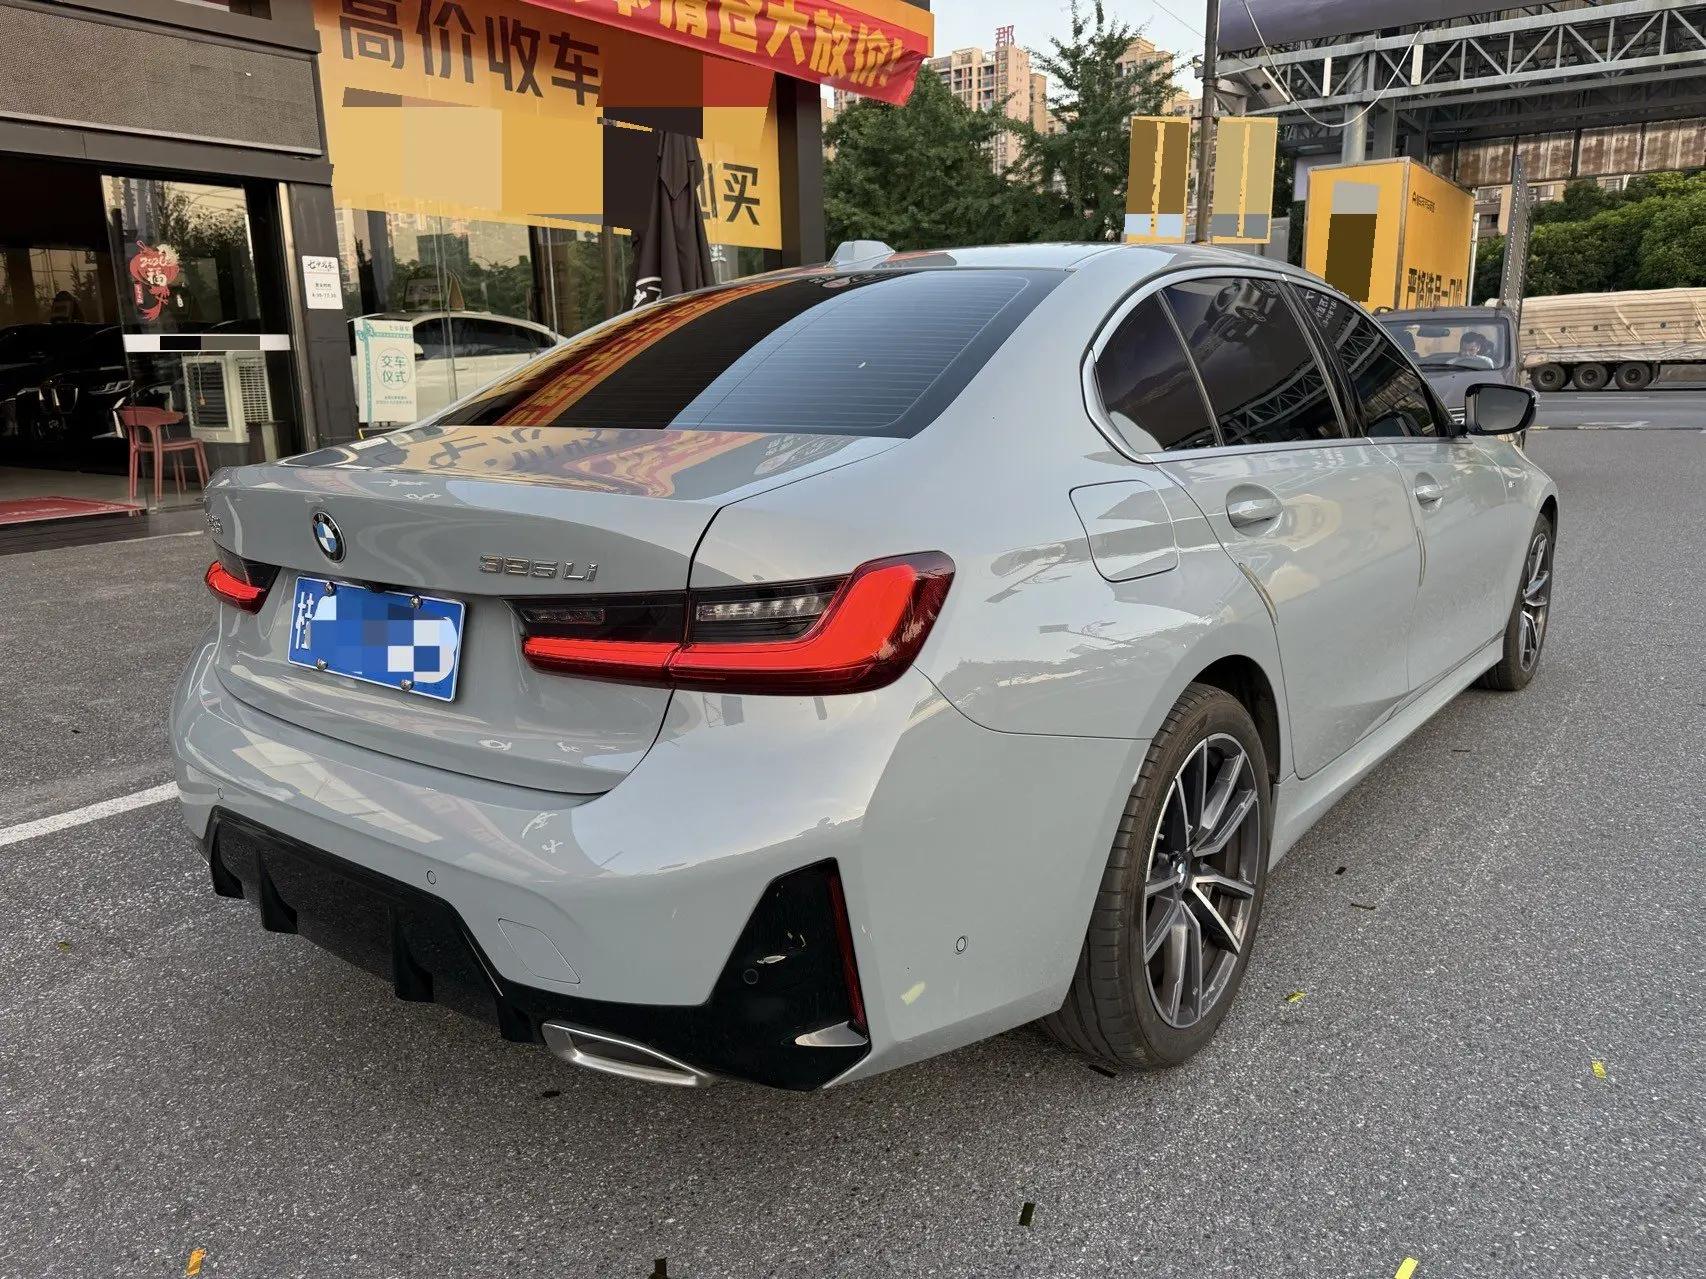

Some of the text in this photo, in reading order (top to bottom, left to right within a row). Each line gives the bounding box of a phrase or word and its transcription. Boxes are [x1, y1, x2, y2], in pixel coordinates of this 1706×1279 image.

[339, 0, 601, 106] 高价收车
[381, 355, 407, 369] 交车
[382, 370, 407, 384] 仪式
